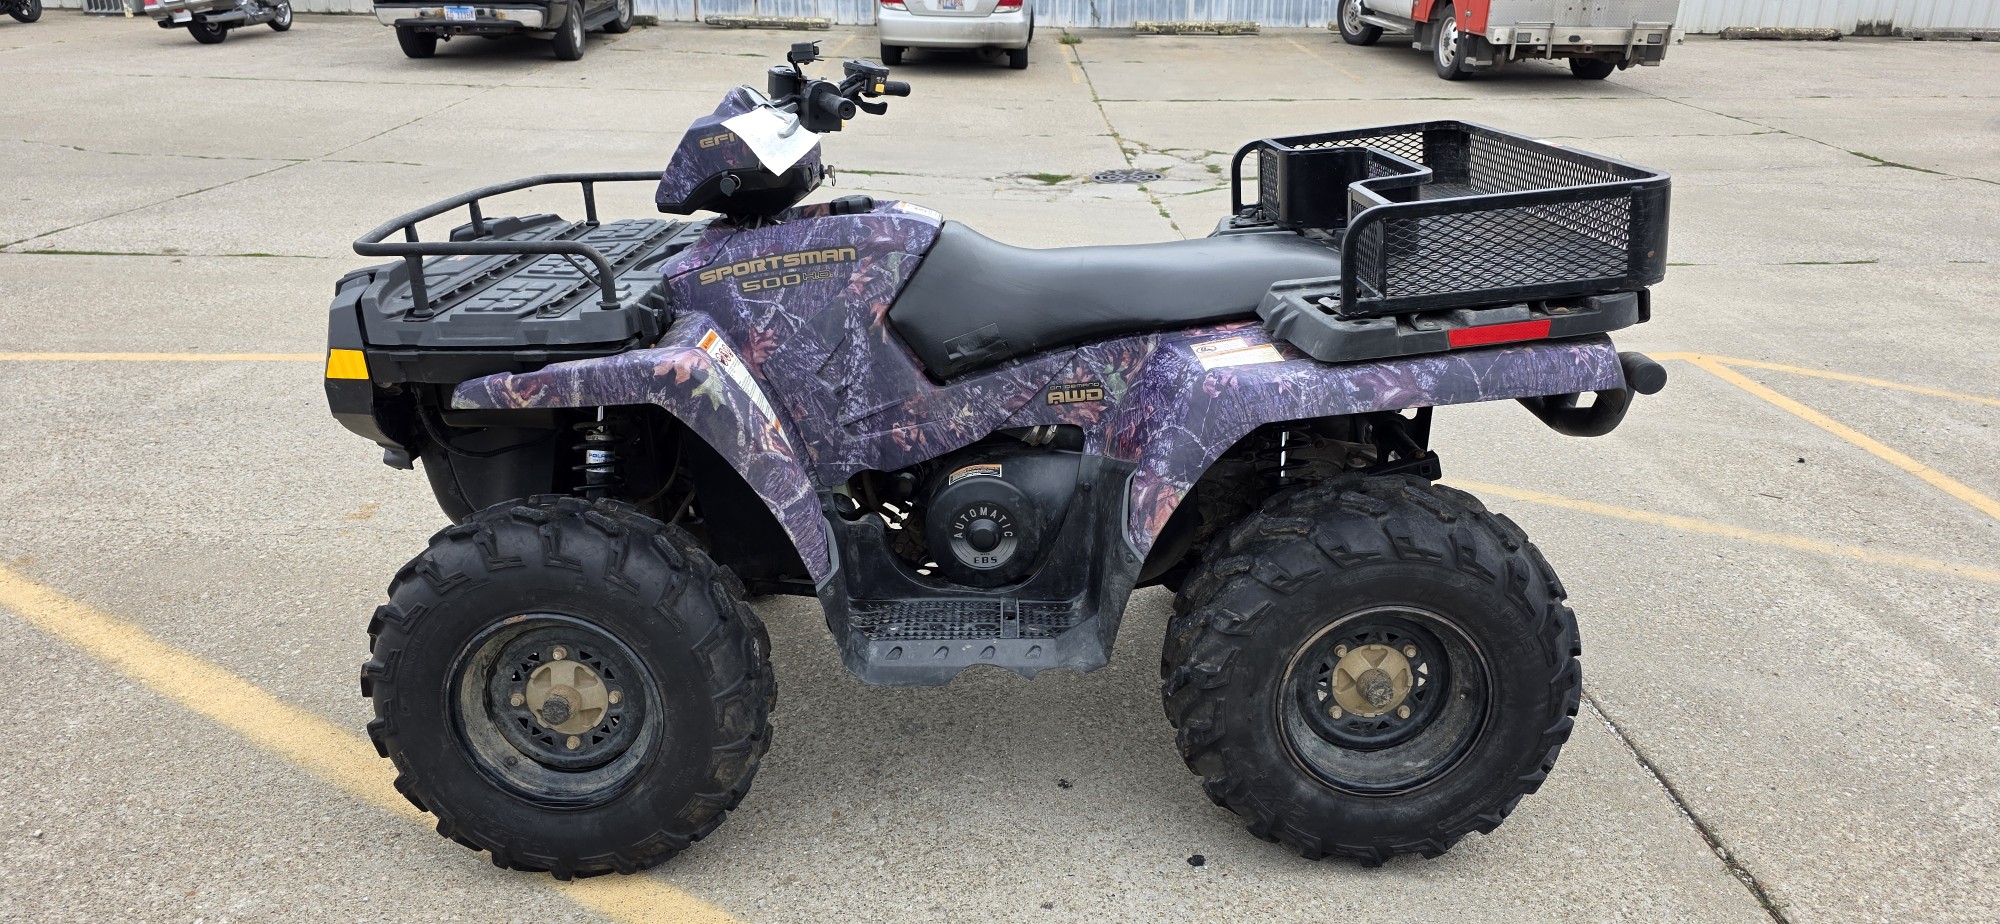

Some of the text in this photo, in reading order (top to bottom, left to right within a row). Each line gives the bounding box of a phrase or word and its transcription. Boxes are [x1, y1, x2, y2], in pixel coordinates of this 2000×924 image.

[699, 132, 735, 149] EFI
[700, 248, 856, 286] SPORTSMAN
[742, 270, 834, 292] 500 H.D.
[1047, 388, 1103, 405] AWD
[954, 506, 1013, 539] AUTOMATIC
[974, 556, 997, 564] EBS
